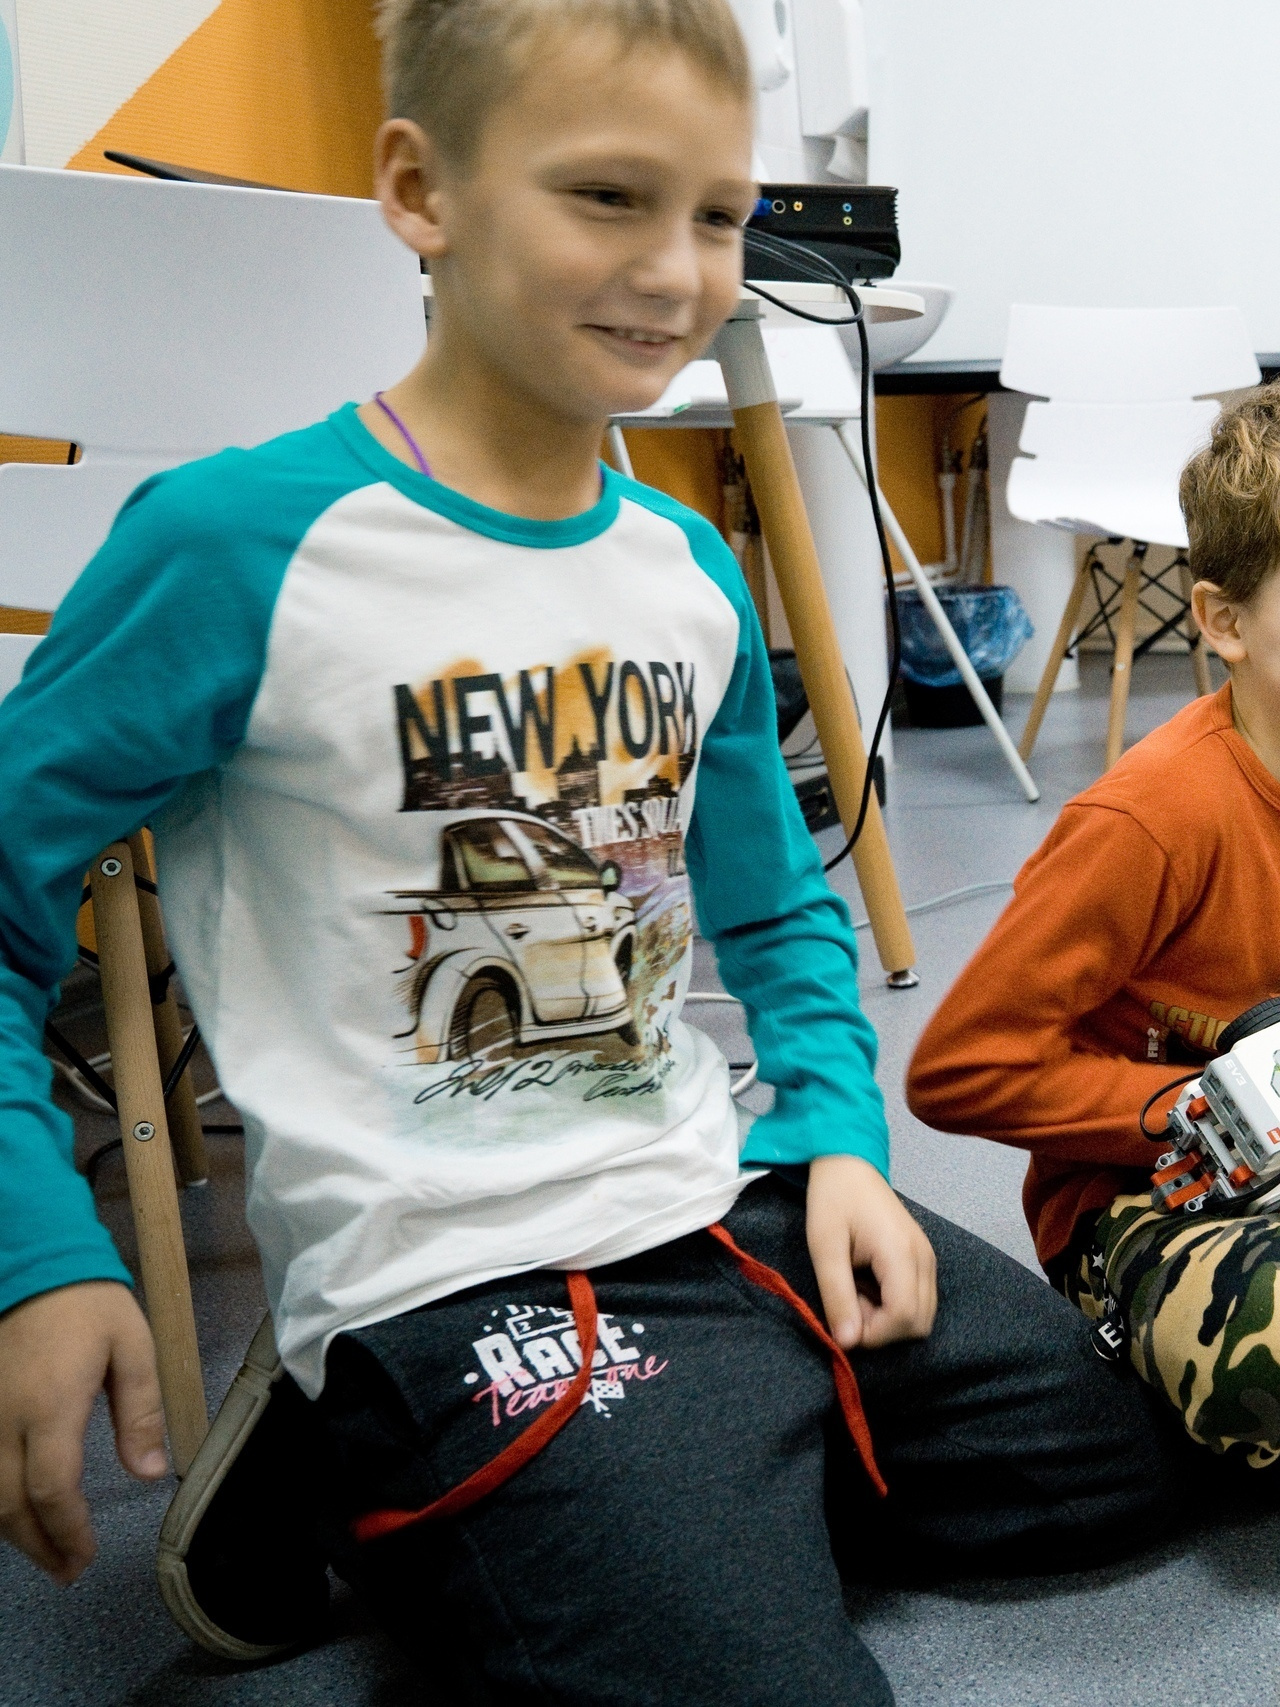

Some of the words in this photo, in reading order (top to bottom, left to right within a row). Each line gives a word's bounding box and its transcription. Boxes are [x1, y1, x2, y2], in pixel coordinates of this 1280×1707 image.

[394, 667, 555, 784] NEW
[577, 660, 697, 760] YORK
[1224, 1058, 1247, 1086] EV3
